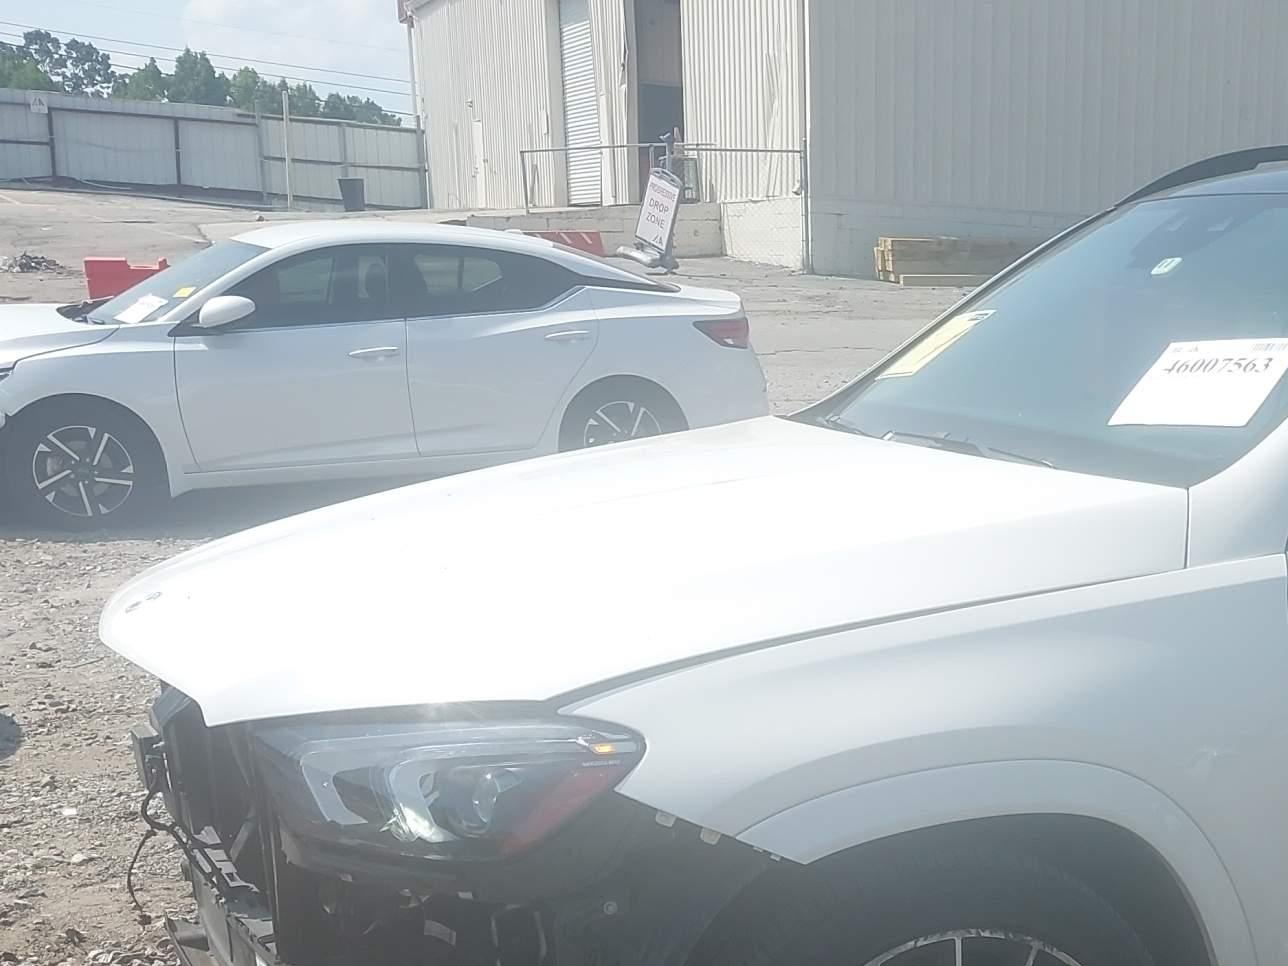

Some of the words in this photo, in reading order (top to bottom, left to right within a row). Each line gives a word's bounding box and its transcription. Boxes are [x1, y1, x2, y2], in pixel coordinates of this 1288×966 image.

[649, 197, 669, 214] DROP
[646, 211, 665, 229] ZONE
[1163, 357, 1274, 374] 46007563
